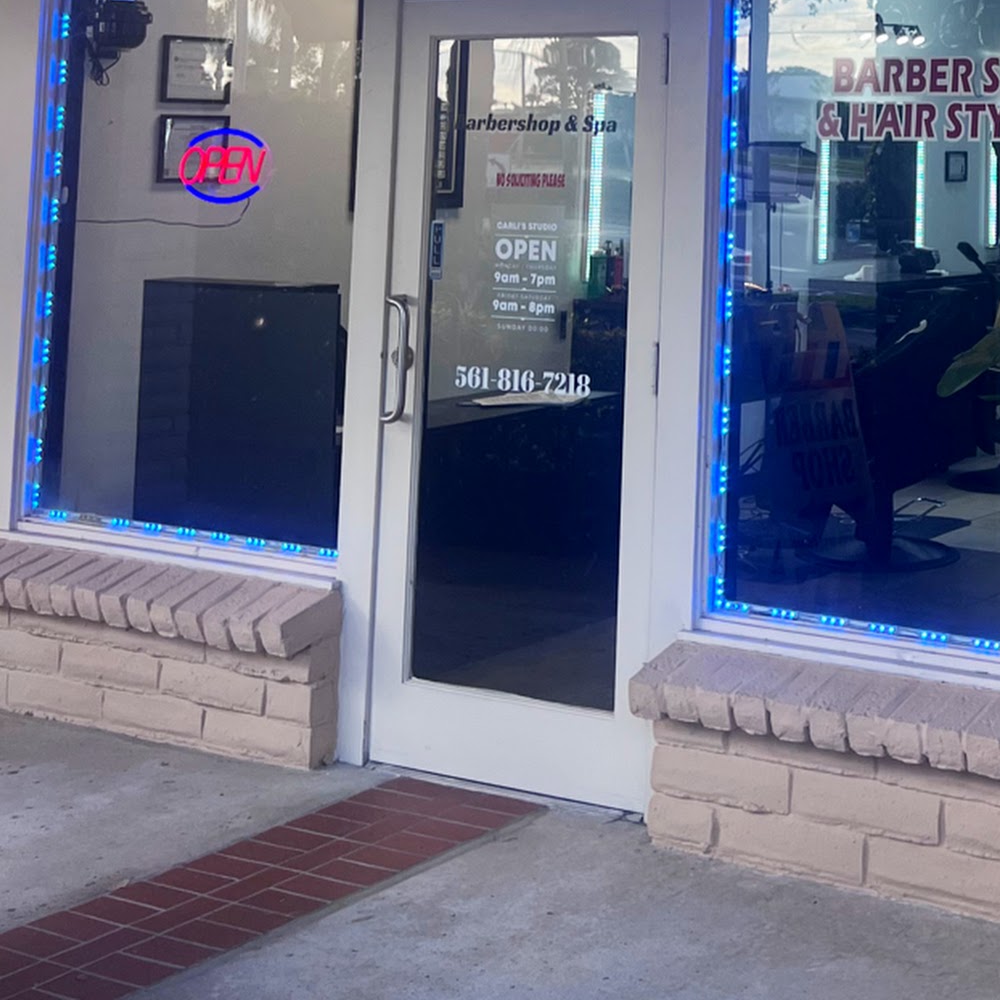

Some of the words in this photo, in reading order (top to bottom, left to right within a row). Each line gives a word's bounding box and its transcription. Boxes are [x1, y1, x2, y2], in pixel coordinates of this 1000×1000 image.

[832, 56, 974, 96] BARBER
[455, 113, 561, 136] arbershop
[564, 115, 578, 133] &
[581, 115, 618, 136] Spa
[817, 101, 842, 140] &
[848, 101, 938, 140] HAIR
[178, 146, 267, 185] OPEN
[528, 222, 558, 232] STUDIO
[495, 238, 557, 262] OPEN
[494, 271, 520, 284] 9am
[530, 273, 556, 288] 7pm
[492, 299, 519, 311] 9am
[528, 301, 555, 316] 8pm
[454, 366, 592, 398] 561-816-7218
